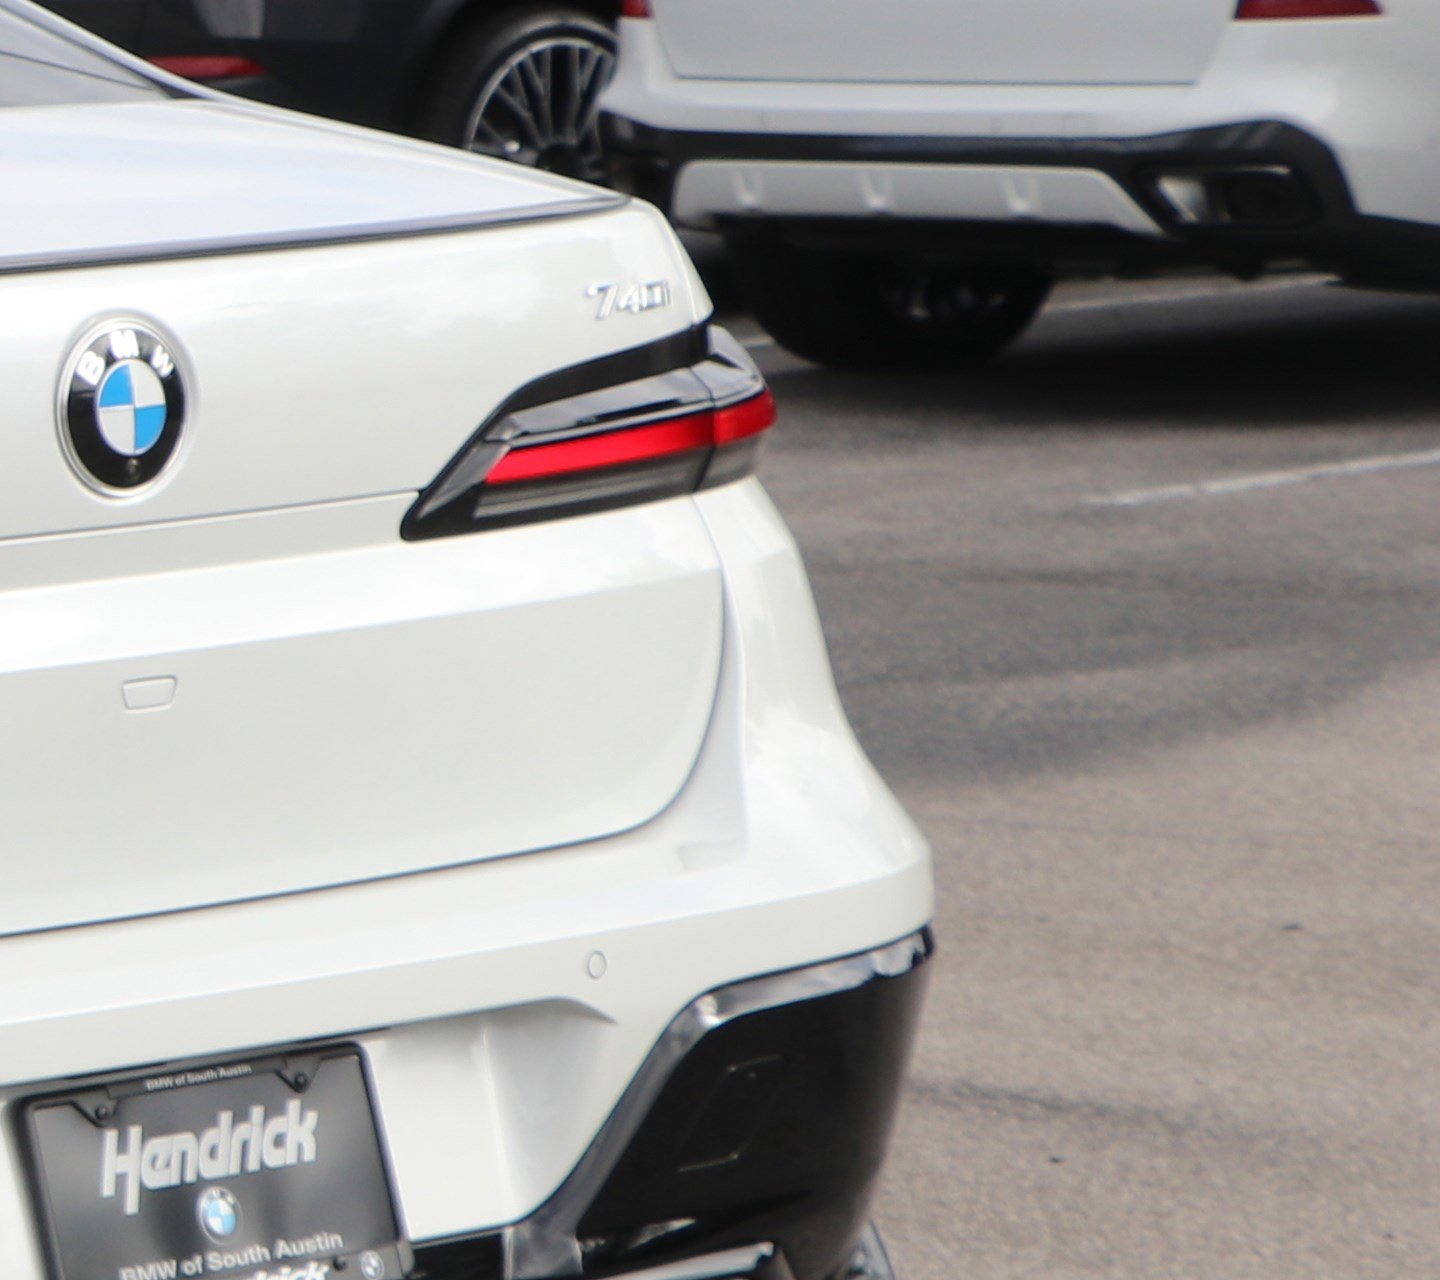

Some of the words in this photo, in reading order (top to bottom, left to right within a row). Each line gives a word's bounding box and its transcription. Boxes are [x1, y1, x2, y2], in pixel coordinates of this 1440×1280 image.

[76, 328, 175, 386] BMW
[145, 1077, 175, 1092] BMW
[175, 1074, 187, 1088] of
[187, 1069, 219, 1085] South
[219, 1063, 253, 1080] Austin
[100, 1097, 320, 1216] Hendrick
[183, 1255, 205, 1277] of
[208, 1243, 271, 1271] South
[274, 1231, 345, 1259] Austin
